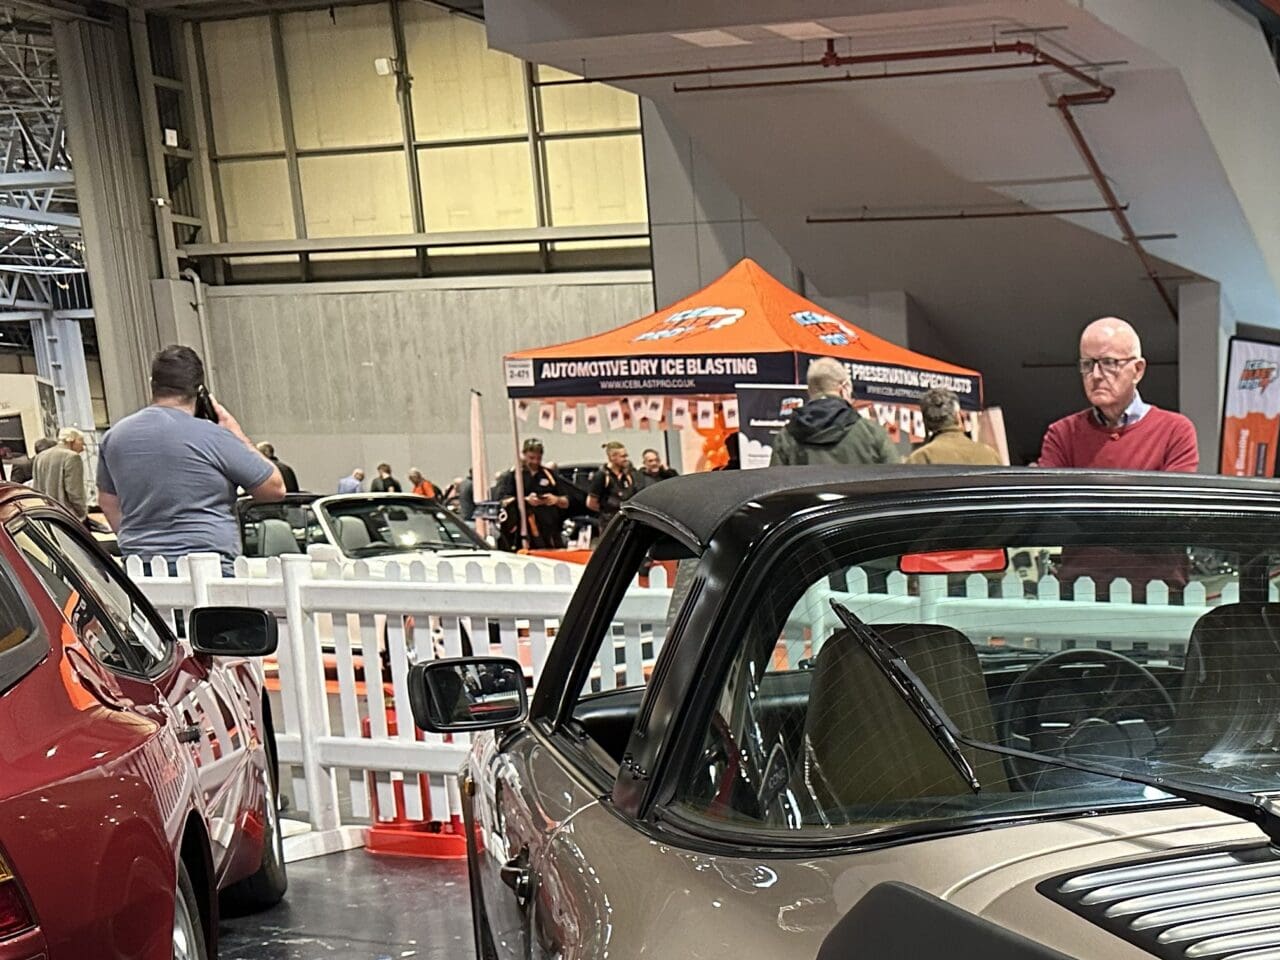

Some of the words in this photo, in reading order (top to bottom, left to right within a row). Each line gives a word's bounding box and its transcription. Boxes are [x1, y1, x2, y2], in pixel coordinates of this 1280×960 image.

[541, 360, 628, 379] AUTOMOTIVE
[631, 359, 658, 376] DRY
[661, 358, 684, 376] ICE
[686, 357, 758, 376] BLASTING
[852, 362, 920, 388] PRESERVATION
[919, 372, 972, 394] SPECIALISTS
